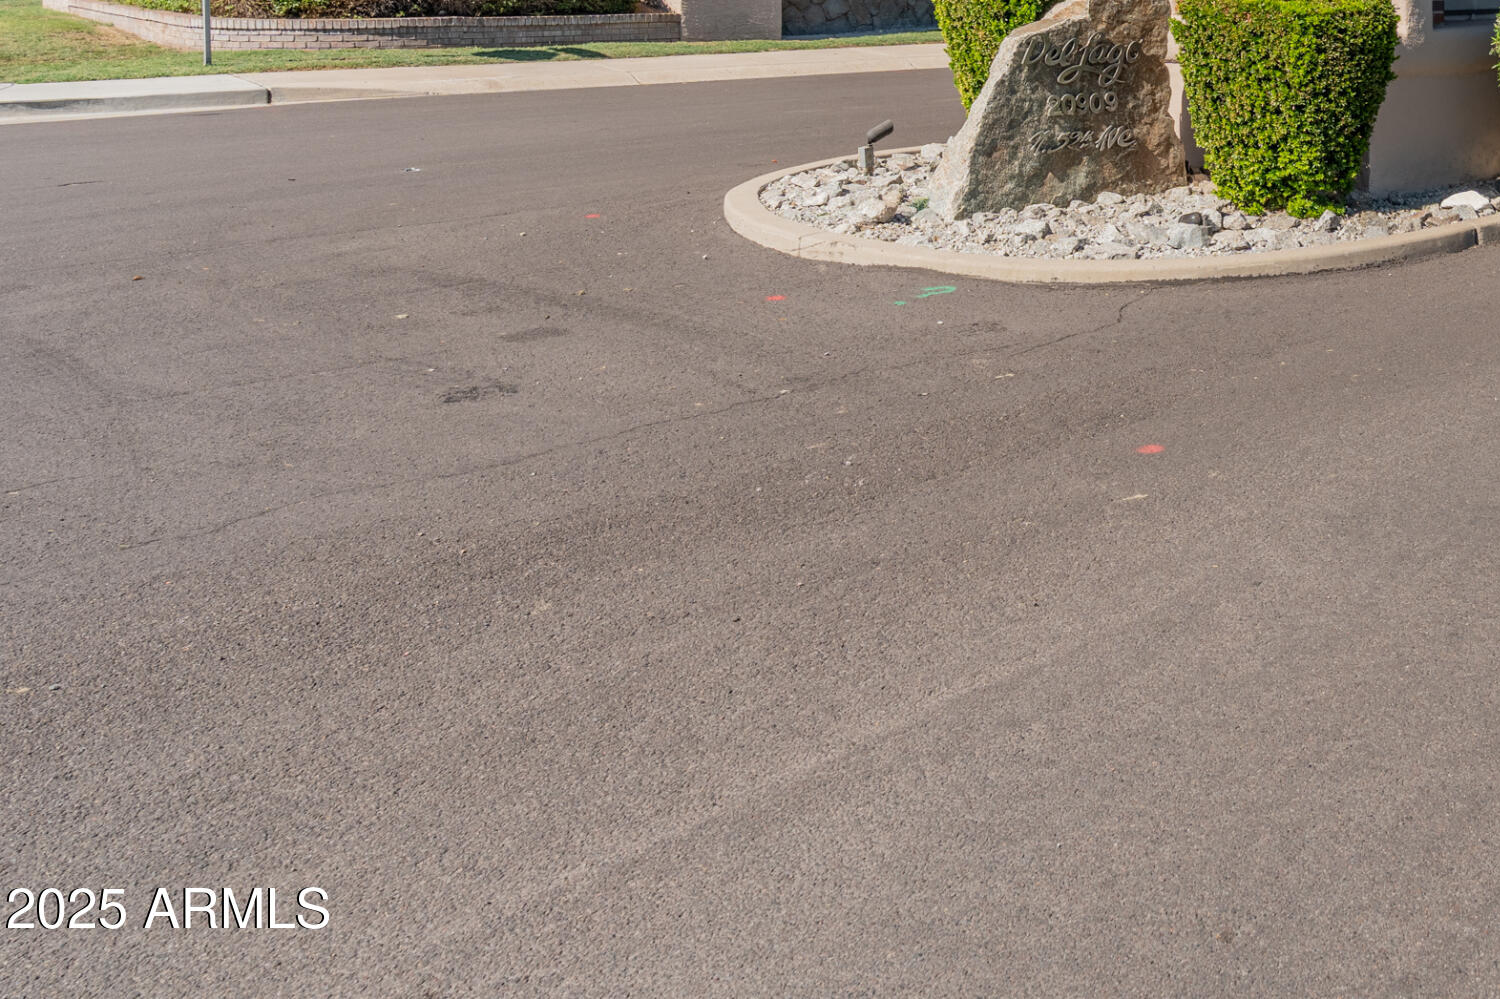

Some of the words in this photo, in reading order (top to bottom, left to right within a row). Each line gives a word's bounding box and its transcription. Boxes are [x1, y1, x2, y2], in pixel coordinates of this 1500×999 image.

[1021, 33, 1078, 67] Del
[1057, 31, 1143, 87] Lago
[1047, 91, 1119, 117] 20909
